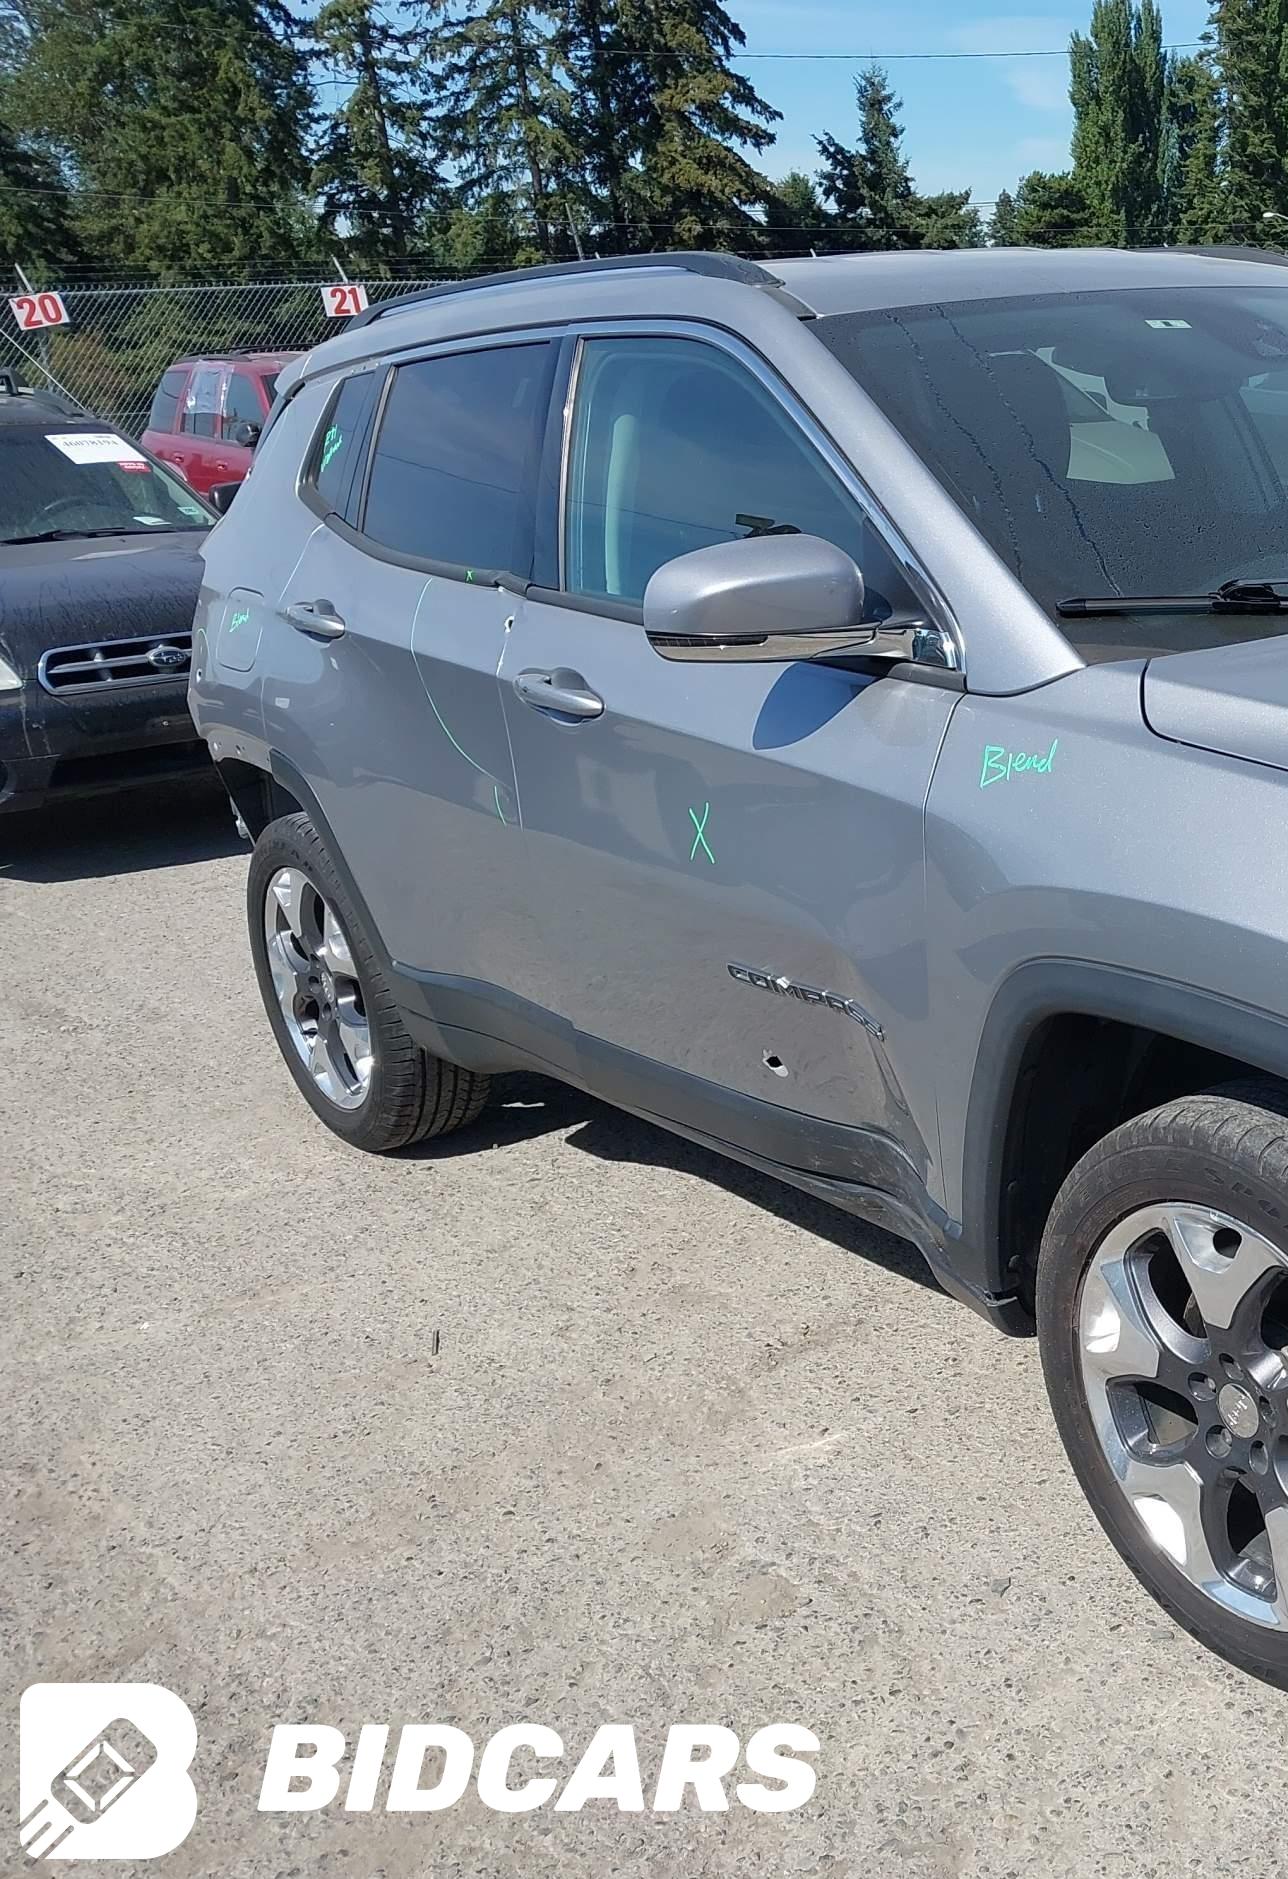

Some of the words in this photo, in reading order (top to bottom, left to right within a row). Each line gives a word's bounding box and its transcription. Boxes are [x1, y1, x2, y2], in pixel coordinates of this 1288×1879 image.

[16, 294, 63, 328] 20
[329, 287, 361, 315] 21
[980, 738, 1058, 790] Blend
